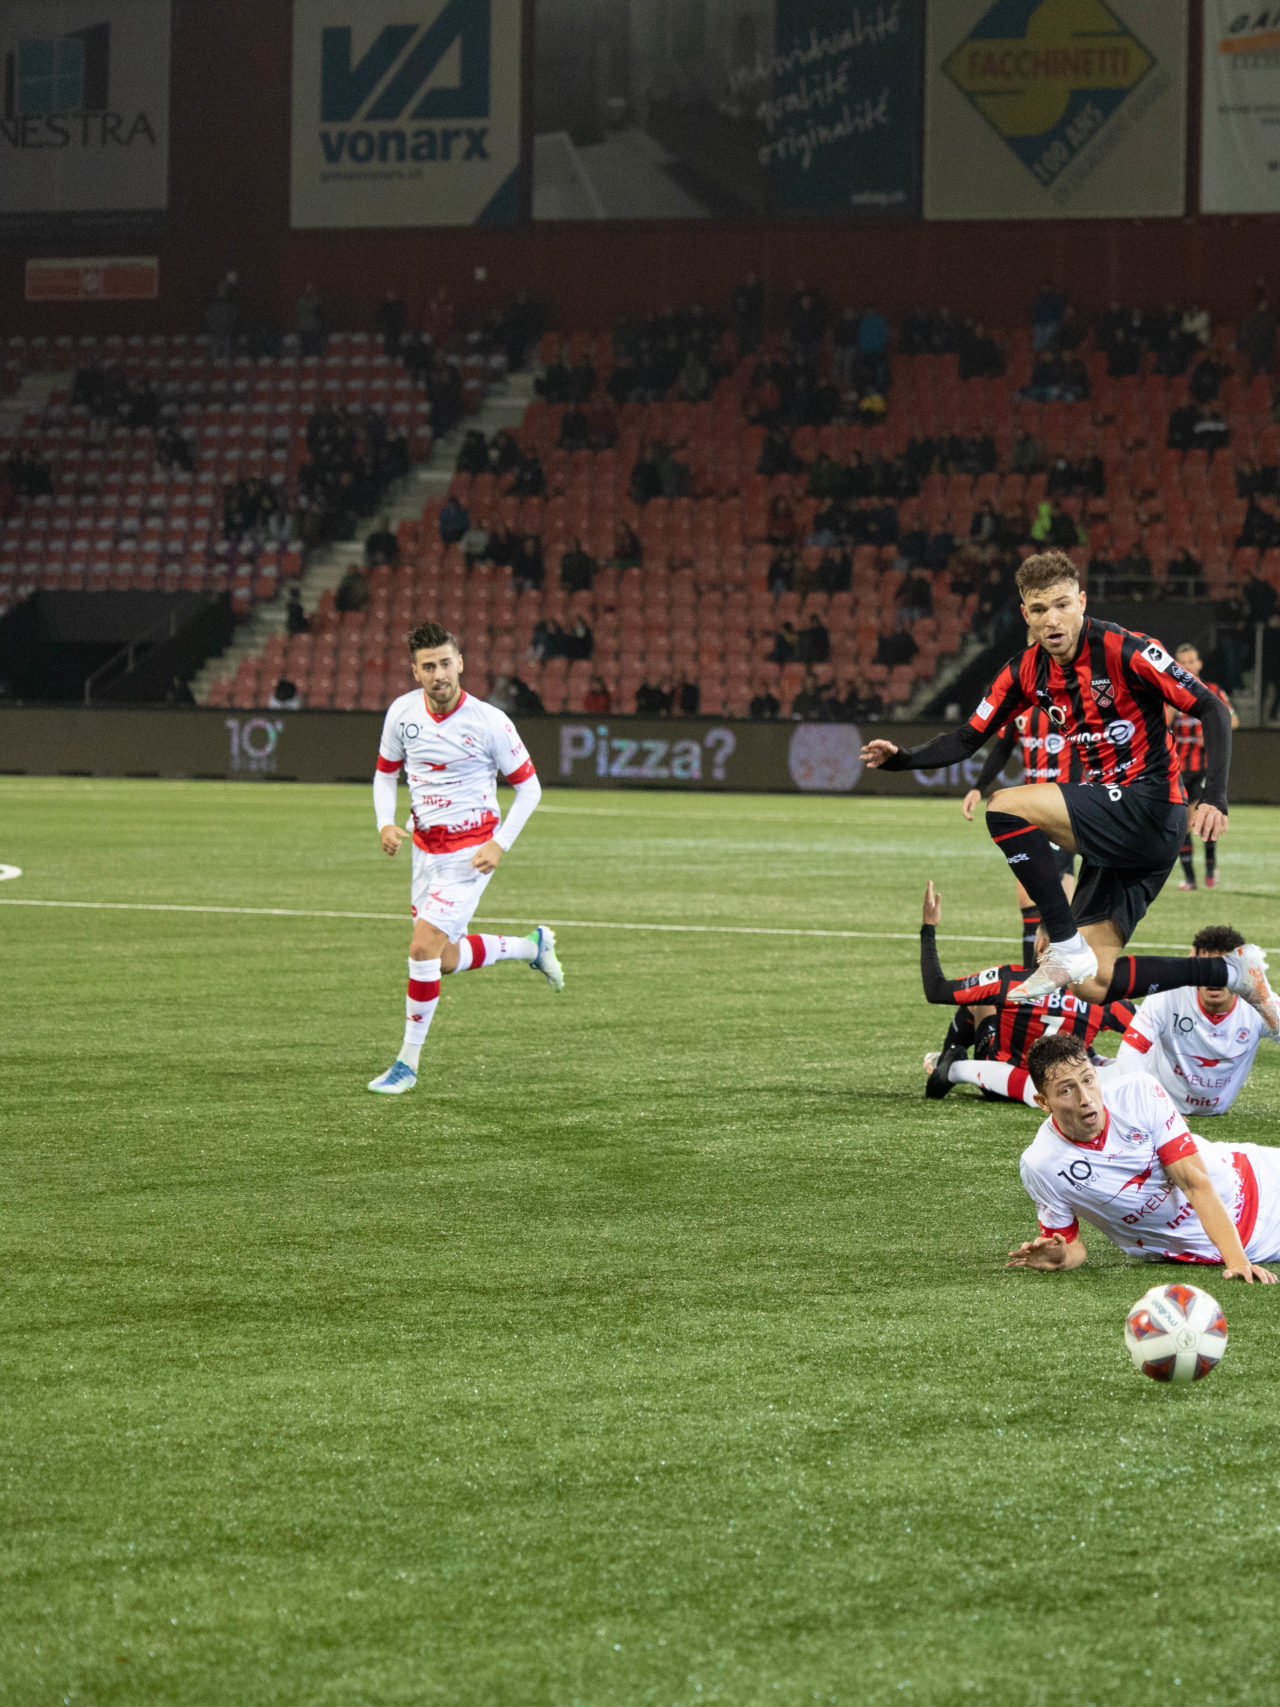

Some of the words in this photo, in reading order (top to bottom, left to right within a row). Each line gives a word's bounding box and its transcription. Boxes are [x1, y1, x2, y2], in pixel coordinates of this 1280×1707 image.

[966, 45, 1130, 80] FACCHINETTI
[318, 127, 491, 164] vonarx
[558, 723, 736, 781] Pizza?
[1047, 993, 1088, 1014] BCN
[1039, 1014, 1066, 1037] 7
[1184, 1093, 1220, 1108] Init7
